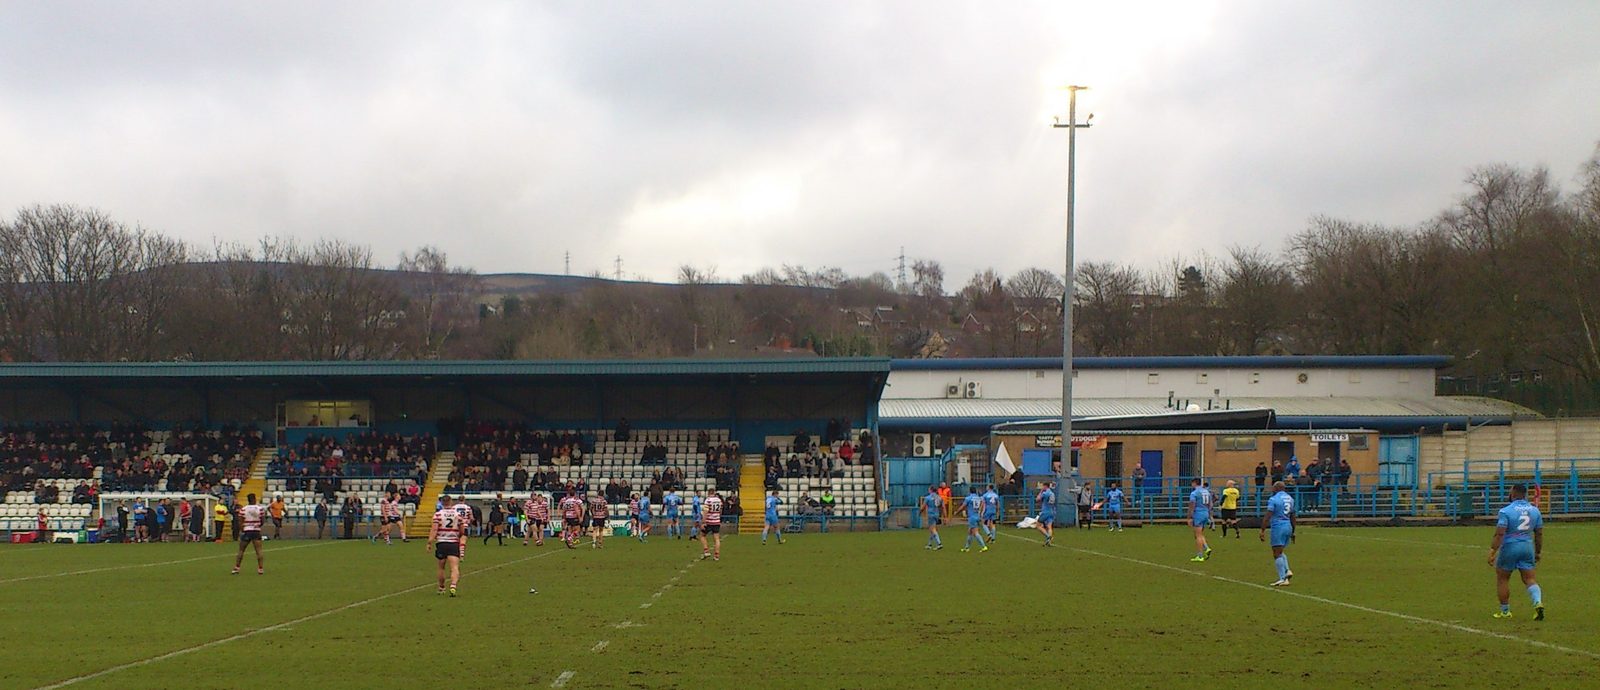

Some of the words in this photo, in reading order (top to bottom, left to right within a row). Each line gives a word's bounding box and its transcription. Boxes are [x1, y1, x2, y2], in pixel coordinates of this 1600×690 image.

[972, 498, 980, 509] 13
[1202, 494, 1209, 504] 11
[712, 503, 720, 512] 12
[1283, 502, 1291, 515] 3
[445, 518, 453, 528] 2
[1517, 515, 1531, 531] 2
